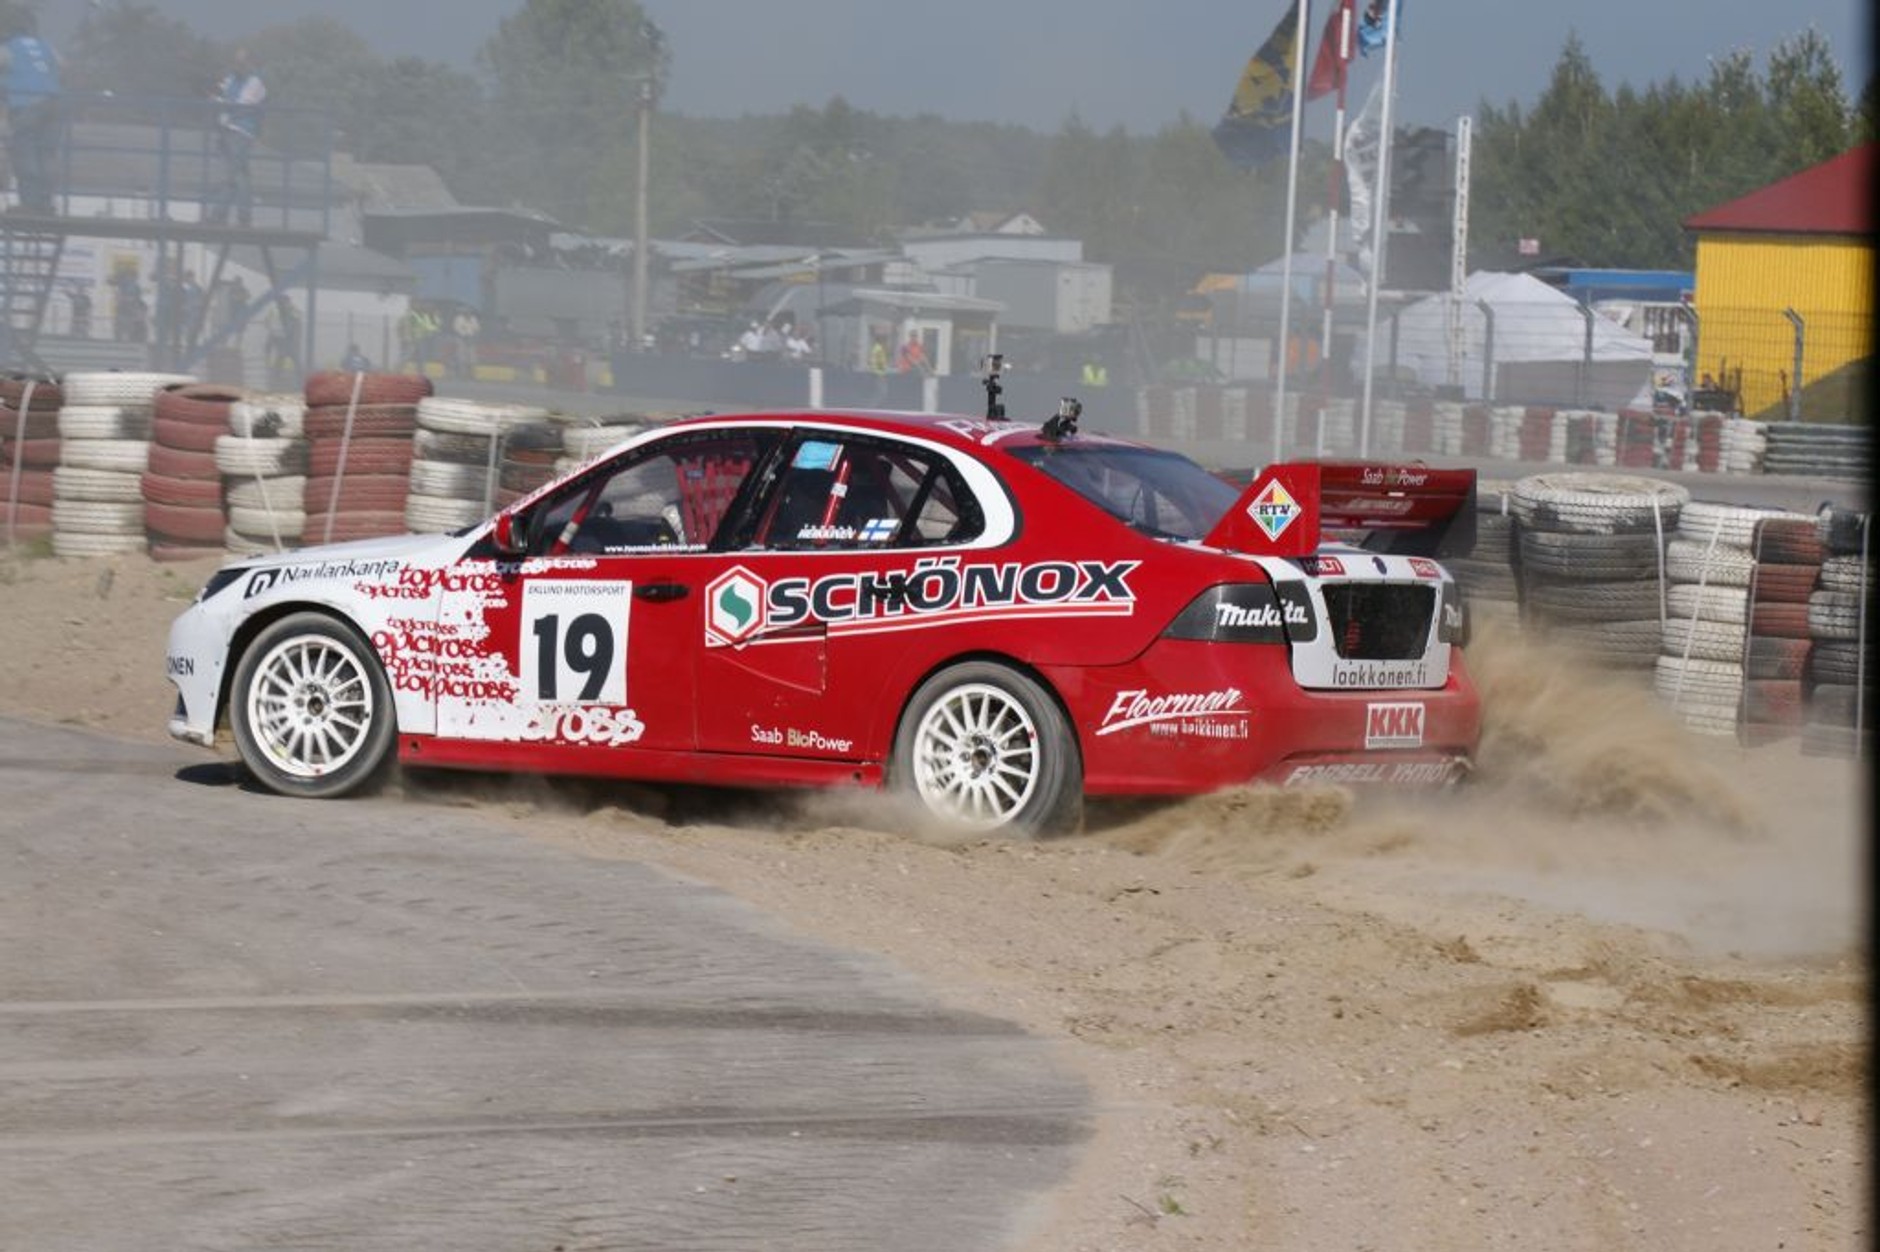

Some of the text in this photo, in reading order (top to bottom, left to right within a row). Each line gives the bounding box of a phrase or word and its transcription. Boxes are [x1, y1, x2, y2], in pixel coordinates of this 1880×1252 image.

[768, 556, 1141, 627] SCHÖNOX
[533, 612, 615, 701] 19
[751, 724, 854, 753] Saab BioPower
[1370, 706, 1423, 736] KKK
